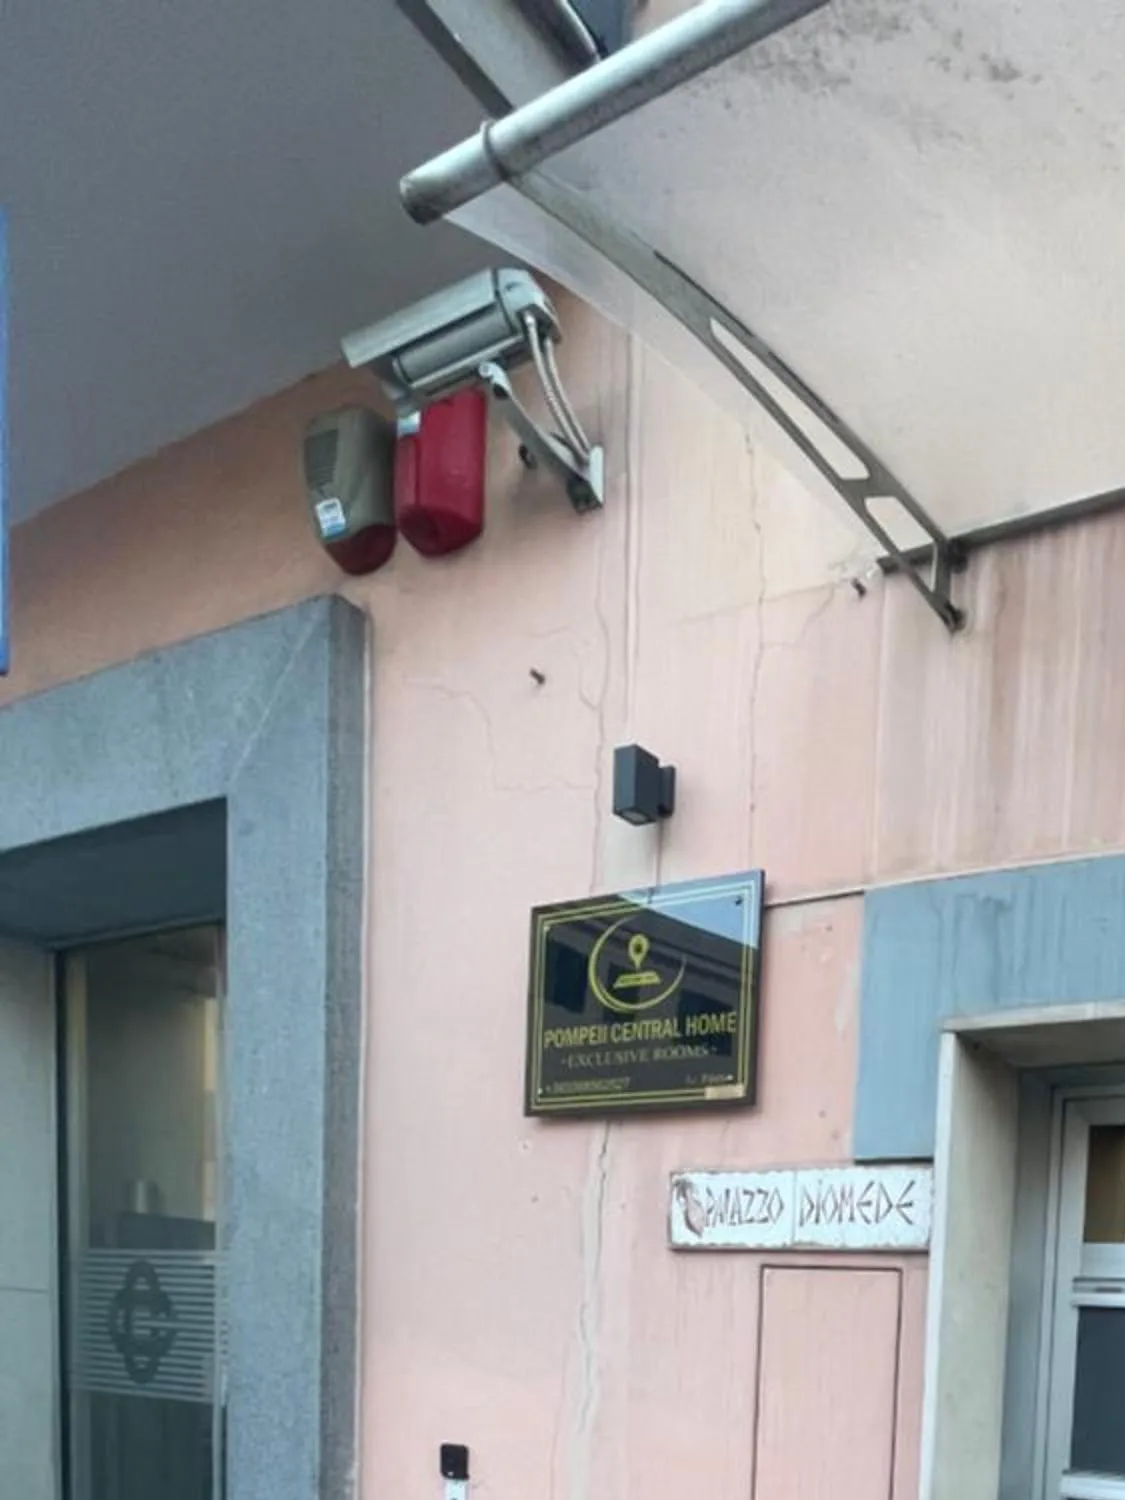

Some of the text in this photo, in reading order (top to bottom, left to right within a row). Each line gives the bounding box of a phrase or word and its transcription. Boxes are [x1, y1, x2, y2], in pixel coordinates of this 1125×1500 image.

[543, 1010, 737, 1049] POMPEII CENTRAL HOME
[704, 1178, 916, 1227] PALAZZO DIOMEDE
